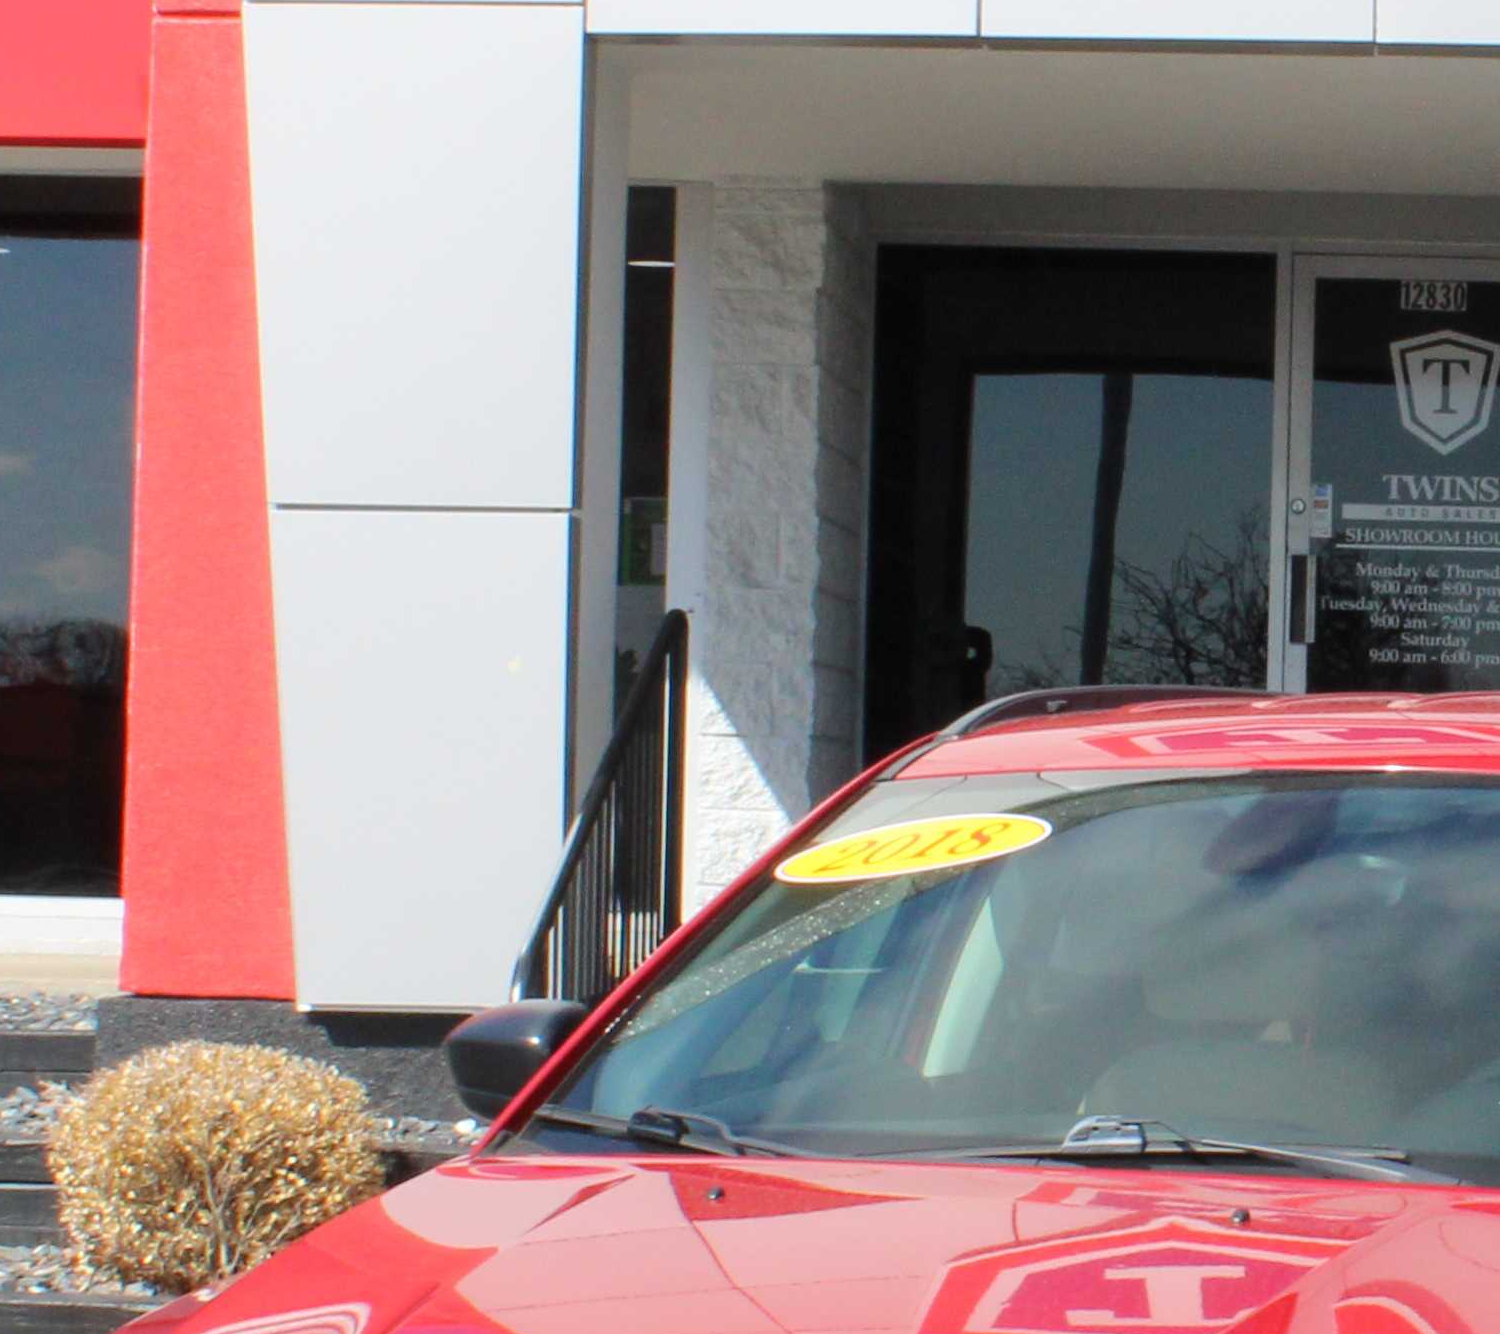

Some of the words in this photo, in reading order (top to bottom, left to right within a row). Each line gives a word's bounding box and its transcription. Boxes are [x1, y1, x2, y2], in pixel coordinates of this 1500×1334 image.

[1402, 282, 1467, 310] 12830
[1422, 358, 1471, 414] T
[1382, 474, 1500, 502] TWINS
[1386, 507, 1429, 517] AUTO
[1443, 508, 1497, 520] SALES
[1346, 527, 1460, 545] SHOWROOM
[1356, 563, 1420, 581] Monday
[1426, 565, 1439, 577] &
[1371, 581, 1399, 594] 9:00
[1404, 584, 1428, 595] am
[1442, 582, 1472, 595] 8:00
[1476, 585, 1500, 599] pm
[1321, 597, 1387, 613] Tuesday,
[1392, 598, 1481, 616] Wednesday
[1486, 600, 1500, 613] &
[1370, 616, 1399, 630] 9:00
[1403, 619, 1428, 629] am
[1441, 617, 1471, 630] 7:00
[1475, 620, 1500, 634] pm
[1401, 632, 1470, 649] Saturday
[1369, 649, 1399, 663] 9:00
[1403, 652, 1427, 663] am
[1440, 650, 1471, 663] 6:00
[1475, 654, 1500, 668] pm
[812, 822, 1010, 874] 2018
